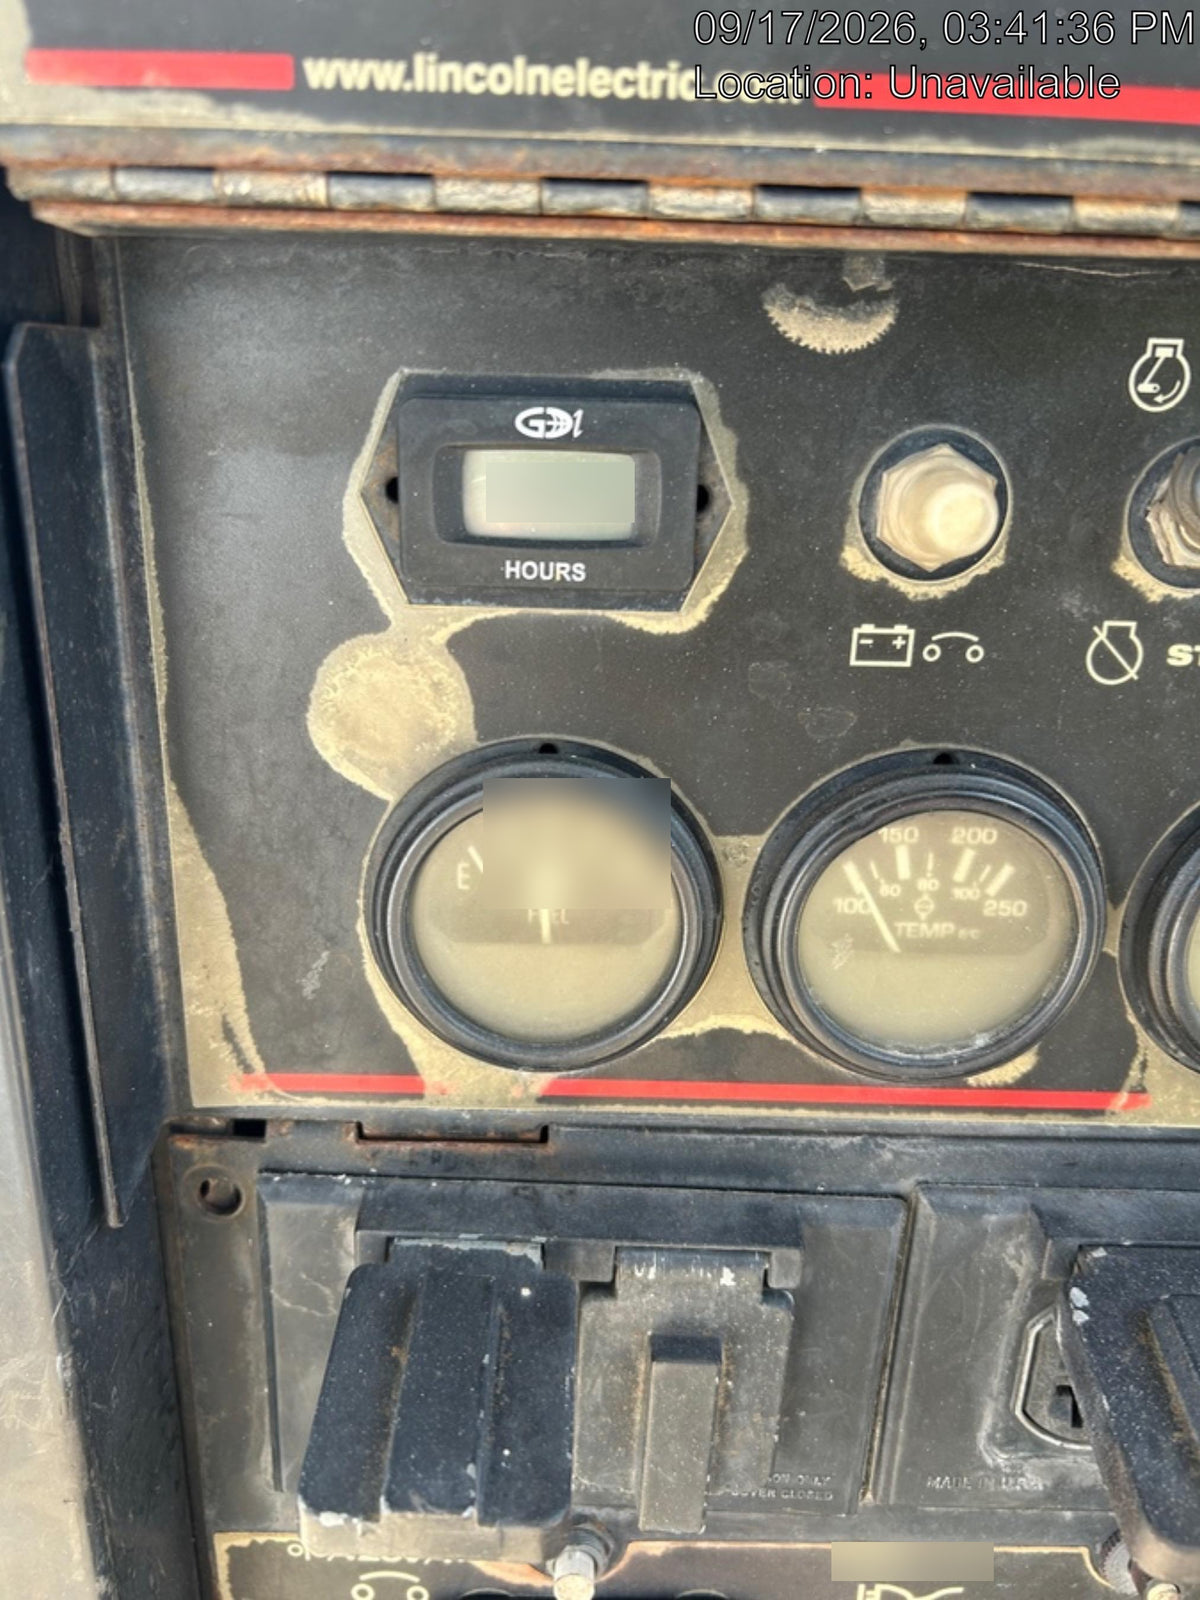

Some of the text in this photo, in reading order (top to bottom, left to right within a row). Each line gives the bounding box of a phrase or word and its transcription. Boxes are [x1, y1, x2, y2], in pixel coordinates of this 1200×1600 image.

[504, 560, 586, 582] HOURS
[878, 826, 919, 843] 150
[951, 826, 998, 844] 200
[457, 862, 470, 890] E
[983, 899, 1028, 917] 250
[894, 922, 956, 940] TEMP
